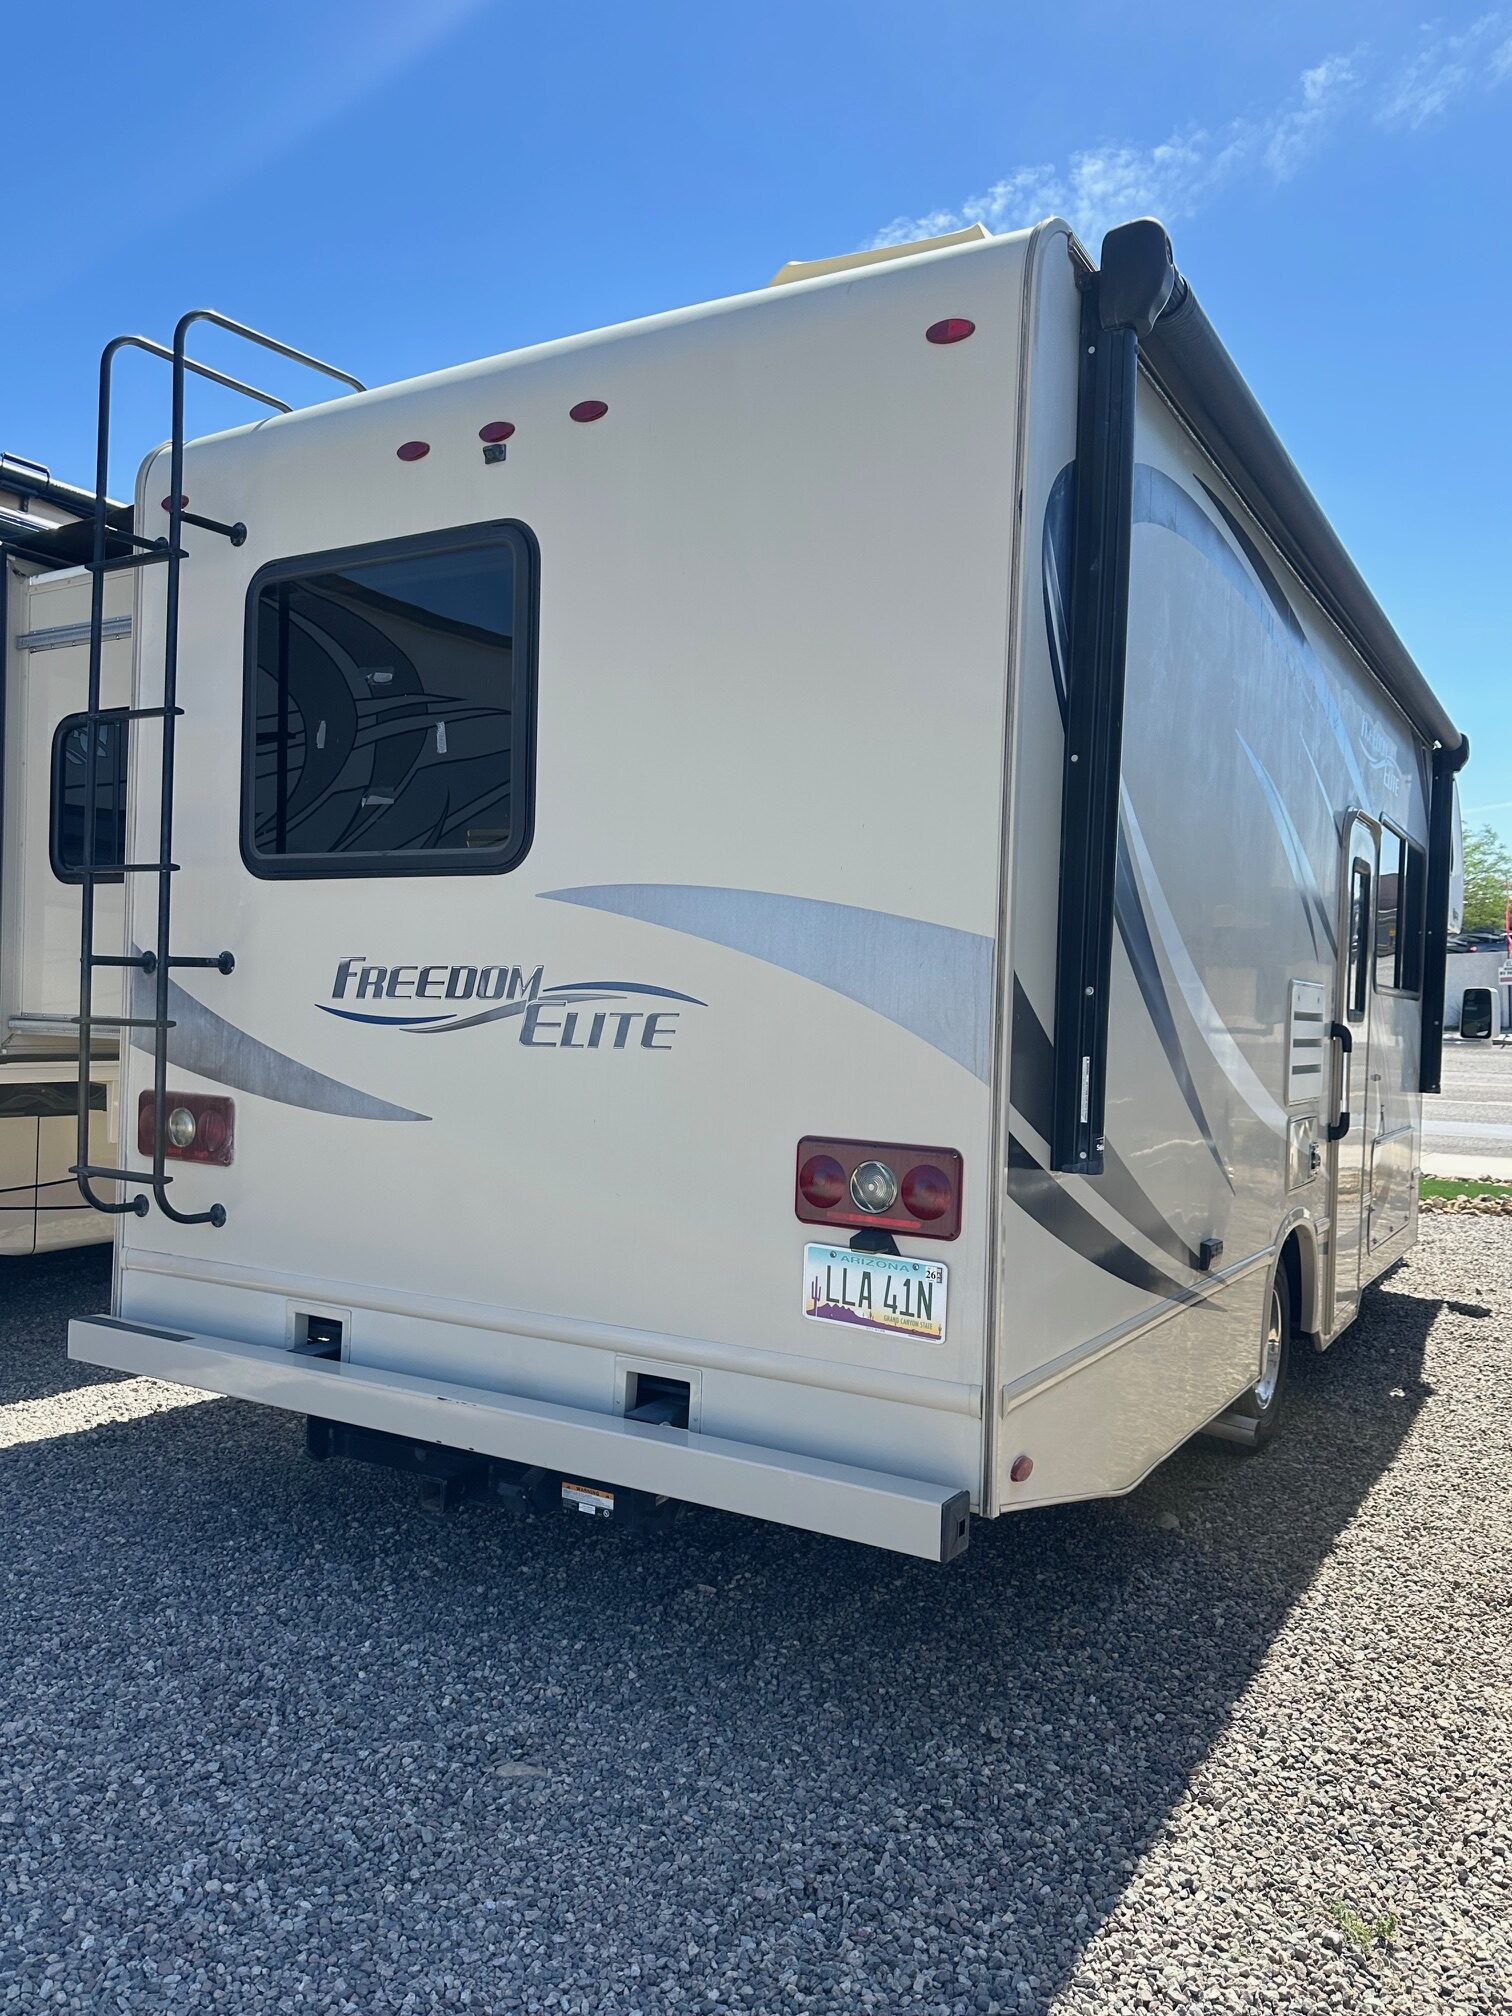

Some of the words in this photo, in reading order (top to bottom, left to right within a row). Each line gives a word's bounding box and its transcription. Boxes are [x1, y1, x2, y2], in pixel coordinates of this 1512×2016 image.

[331, 956, 545, 1001] FREEDOM
[518, 1000, 681, 1051] ELITE
[840, 1254, 910, 1273] ARIZONA
[925, 1270, 936, 1280] 26
[826, 1265, 872, 1310] LLA
[883, 1275, 933, 1321] 41N
[883, 1314, 900, 1324] GRAND
[900, 1318, 919, 1327] CANYON
[920, 1321, 933, 1330] STATE
[576, 1486, 600, 1497] WARNING
